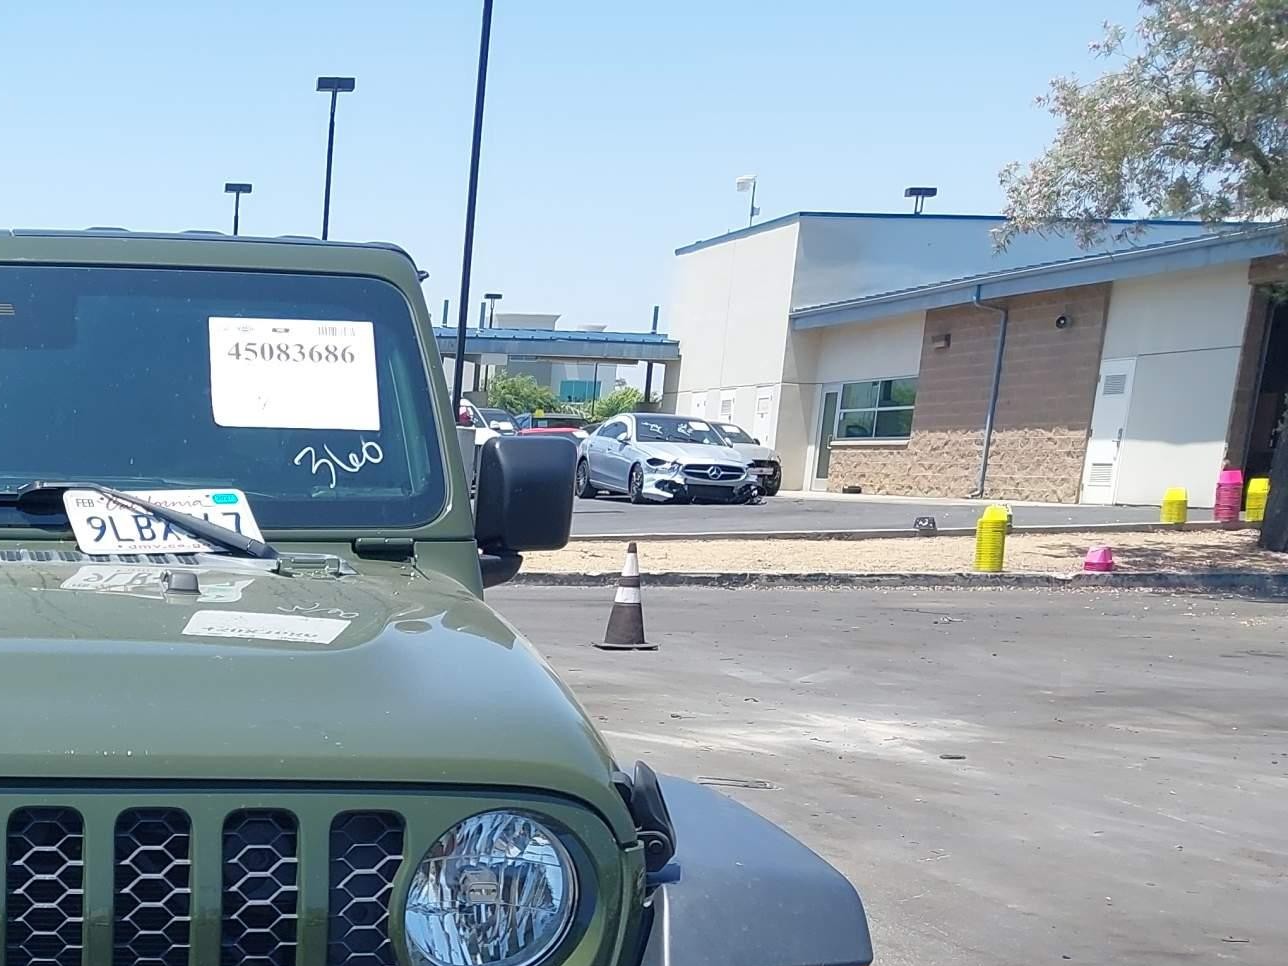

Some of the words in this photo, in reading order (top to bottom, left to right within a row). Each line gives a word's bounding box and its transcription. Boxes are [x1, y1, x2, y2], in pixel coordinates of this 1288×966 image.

[227, 341, 355, 364] 45083686
[294, 435, 383, 488] 360
[76, 499, 95, 508] FEB
[106, 495, 215, 512] Caornia
[86, 512, 244, 542] 9LBX7
[128, 542, 212, 550] dmv.ca.g
